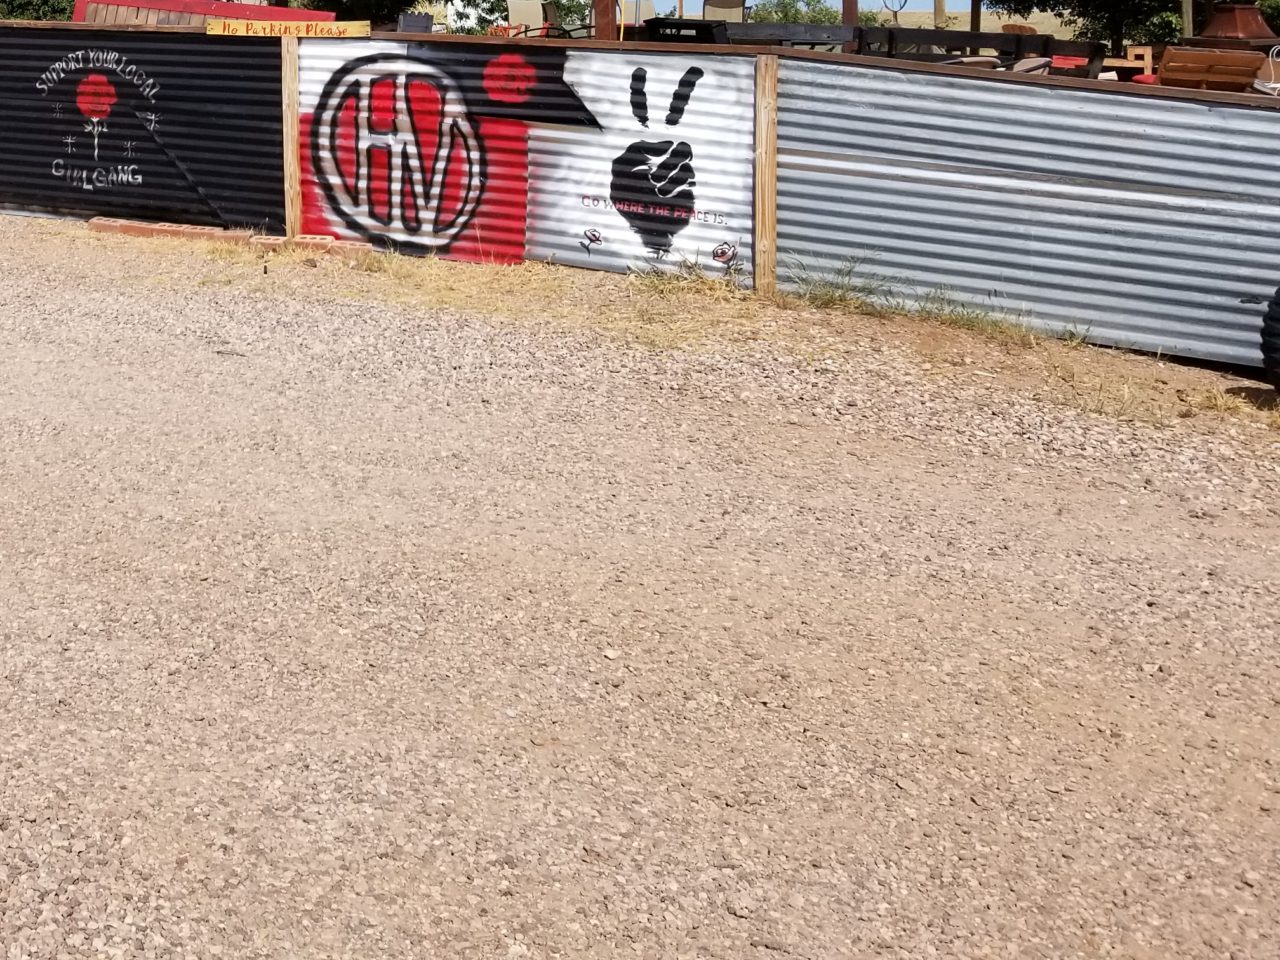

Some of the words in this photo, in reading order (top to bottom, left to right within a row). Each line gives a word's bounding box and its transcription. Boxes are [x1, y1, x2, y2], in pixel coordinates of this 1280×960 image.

[222, 21, 238, 35] No
[245, 21, 301, 37] Parking
[306, 23, 348, 37] Please
[35, 50, 85, 96] SUPPORT
[87, 48, 119, 68] YOUR
[116, 56, 161, 104] LOCAL
[92, 165, 142, 187] GANG
[648, 203, 670, 216] THE
[674, 207, 710, 222] PEACE
